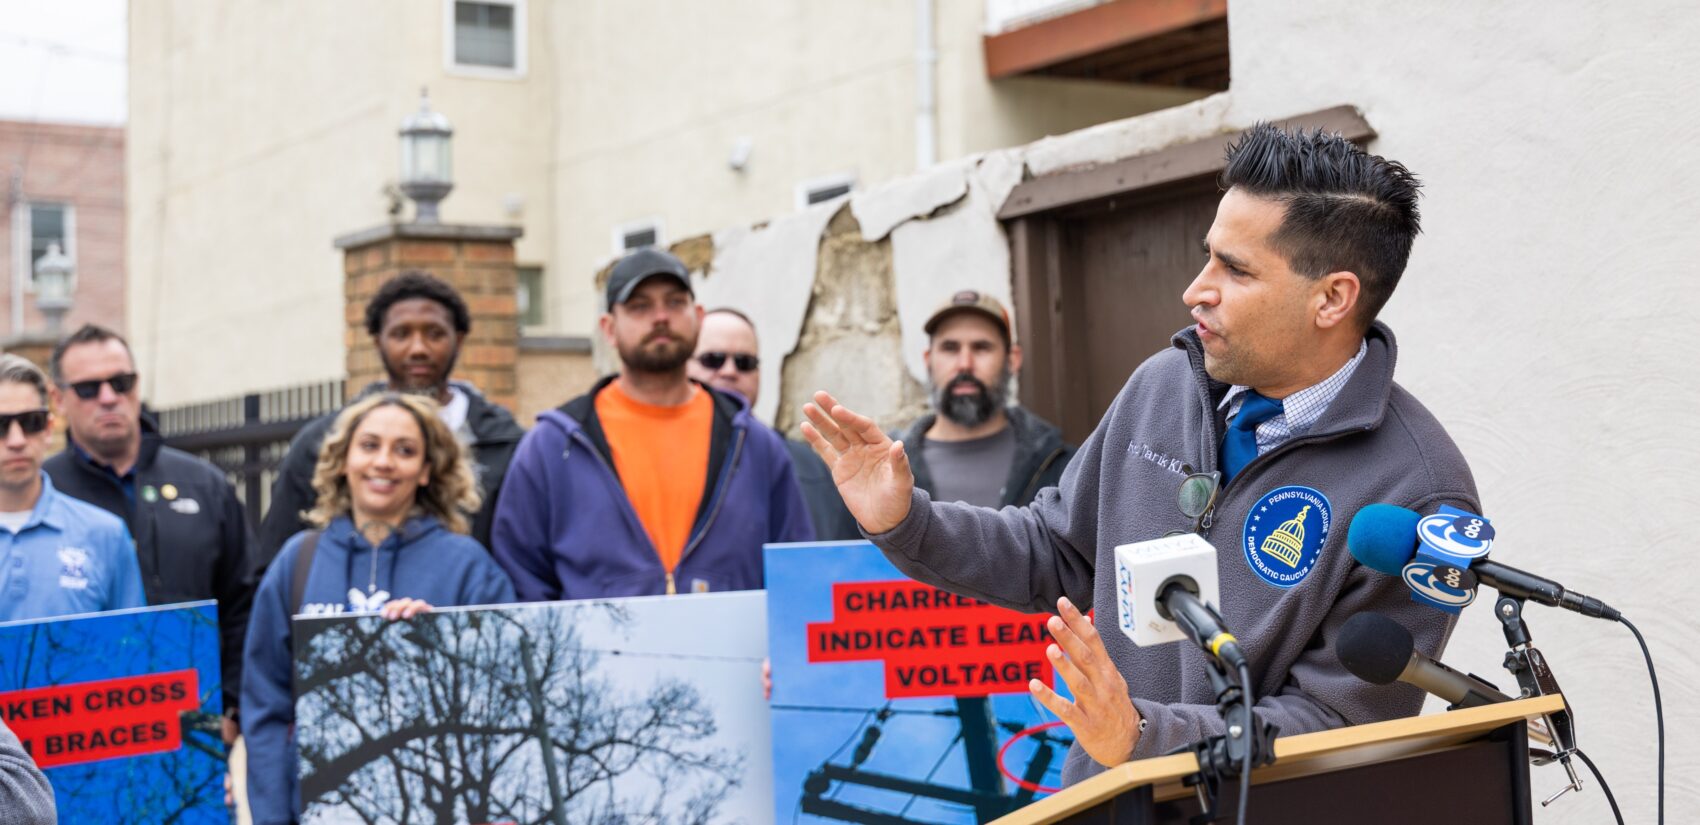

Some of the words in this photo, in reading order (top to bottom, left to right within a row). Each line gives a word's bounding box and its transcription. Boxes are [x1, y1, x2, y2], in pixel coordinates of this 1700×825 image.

[1268, 491, 1324, 510] PENNSYLVANIA
[1320, 507, 1329, 533] HOUSE
[1464, 518, 1484, 538] abc
[1248, 536, 1279, 579] DEMOCRATIC
[1280, 566, 1308, 581] CAUCUS
[1444, 567, 1461, 588] abc
[845, 588, 988, 612] CHARRE
[819, 627, 967, 652] INDICATE
[896, 662, 1043, 687] VOLTAGE
[0, 695, 72, 721] KEN
[84, 681, 188, 711] CROSS
[45, 721, 168, 756] BRACES
